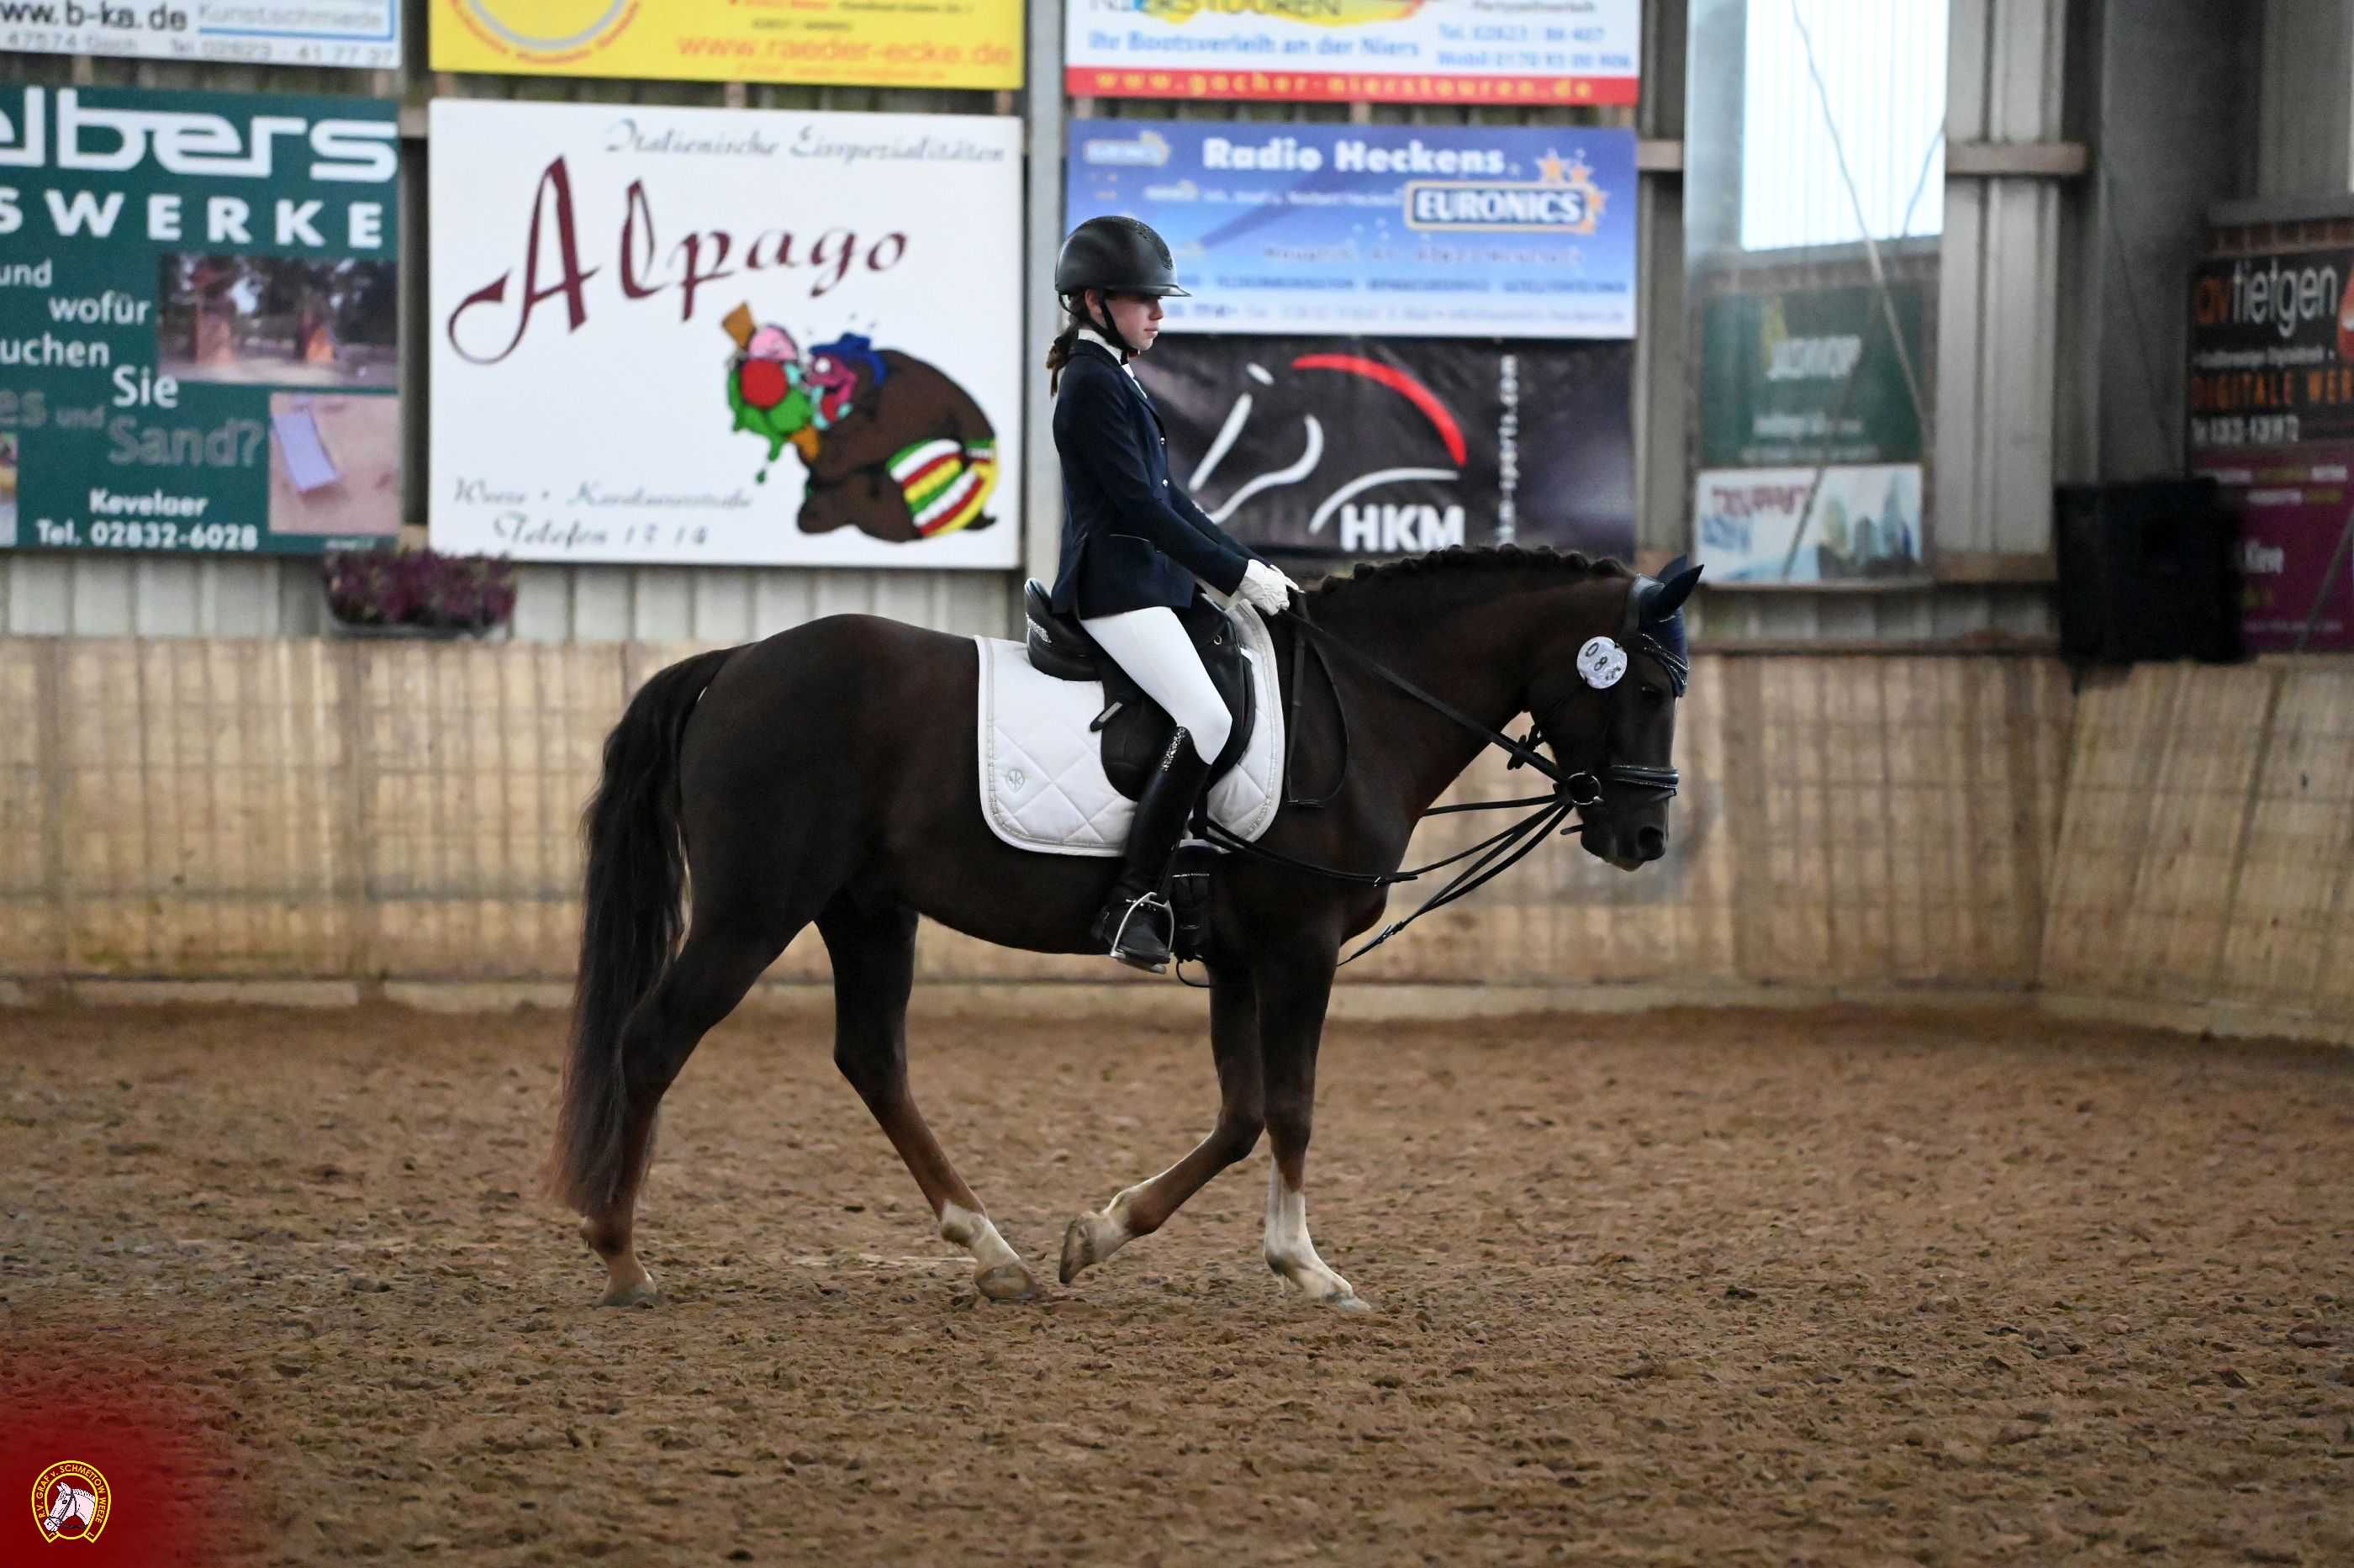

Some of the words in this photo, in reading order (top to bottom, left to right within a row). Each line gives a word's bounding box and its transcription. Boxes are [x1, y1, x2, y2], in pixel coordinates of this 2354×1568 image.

[0, 85, 398, 182] lbers
[1202, 138, 1322, 172] Radio
[1334, 140, 1506, 175] Heckens
[1417, 190, 1581, 223] EURONICS
[447, 154, 909, 365] Alpago
[48, 290, 151, 325] wofür
[112, 364, 179, 409] Sie
[107, 415, 266, 467] Sand?
[37, 519, 82, 546] Tel.
[1340, 504, 1466, 552] HKM
